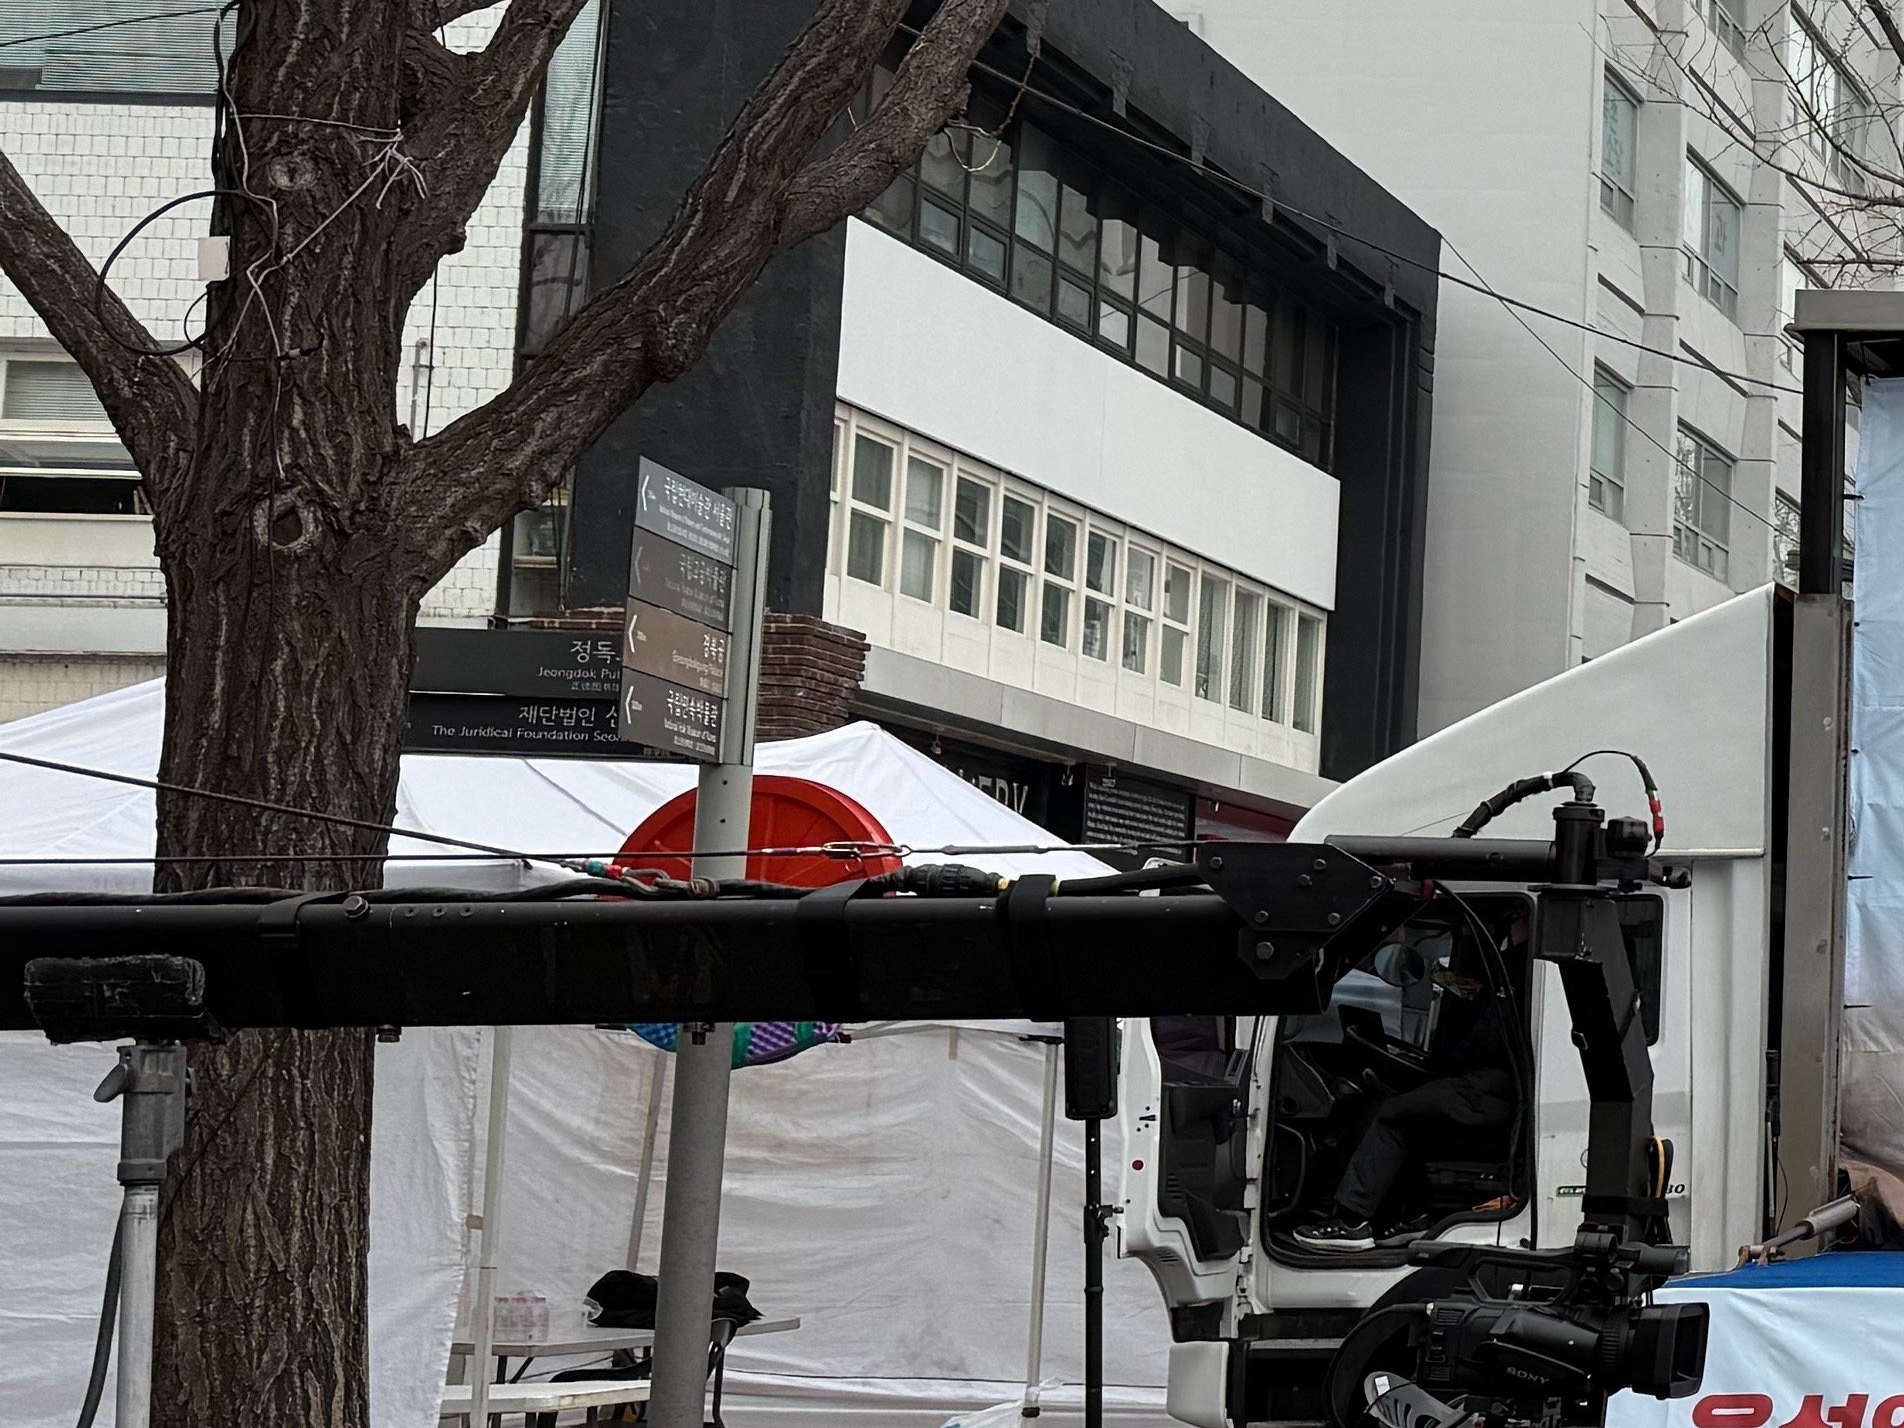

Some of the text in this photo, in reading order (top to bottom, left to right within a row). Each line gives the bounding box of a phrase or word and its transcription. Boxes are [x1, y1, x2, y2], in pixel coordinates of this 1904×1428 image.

[519, 705, 596, 727] 재단법인
[432, 724, 621, 742] The Juridical Foundation Seo
[1506, 1366, 1550, 1385] SONY
